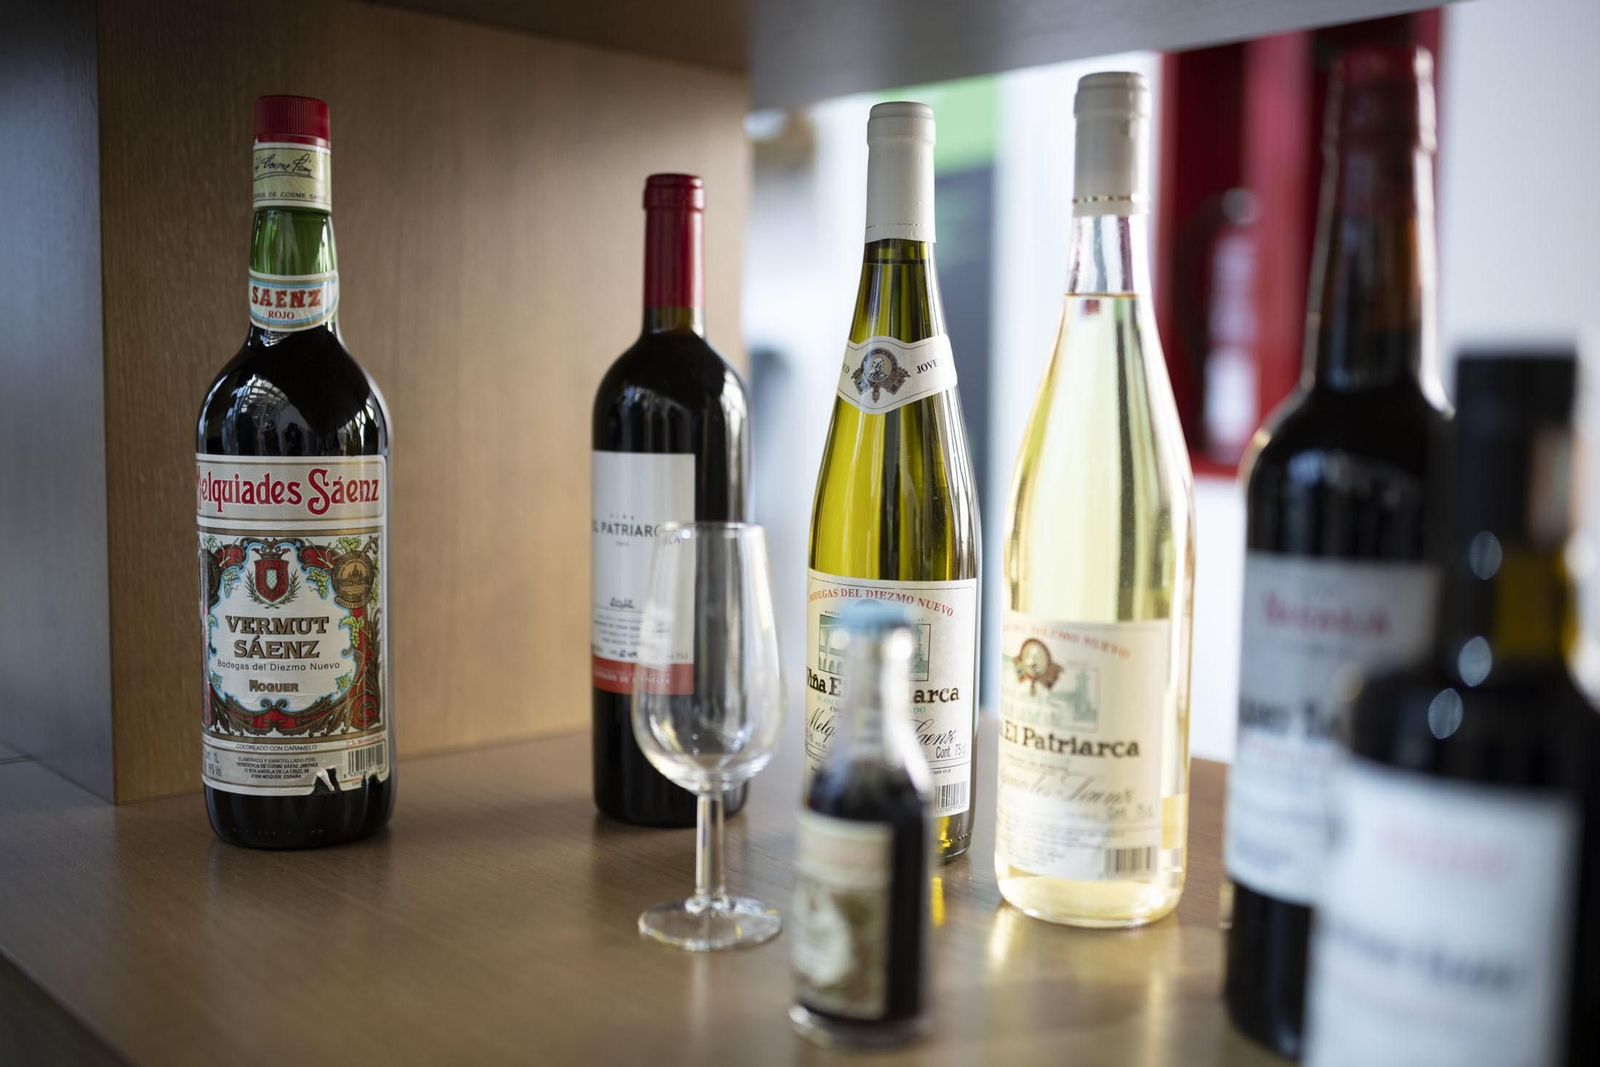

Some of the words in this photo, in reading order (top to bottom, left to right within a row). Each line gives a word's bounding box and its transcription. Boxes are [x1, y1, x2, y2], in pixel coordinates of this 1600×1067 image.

[252, 285, 321, 309] SAENZ
[268, 310, 295, 320] ROJO
[307, 468, 380, 515] Sáenz
[841, 588, 862, 598] DEL
[865, 589, 914, 605] DIEZMO
[917, 597, 954, 617] NUEVO
[225, 615, 329, 636] VERMUT
[234, 635, 320, 659] SÁENZ
[217, 659, 249, 671] Bodegas
[252, 663, 267, 671] del
[270, 663, 306, 672] Diezmo
[310, 662, 341, 670] Nuevo
[236, 743, 269, 751] COLOREADO
[1023, 727, 1140, 758] Patriarca
